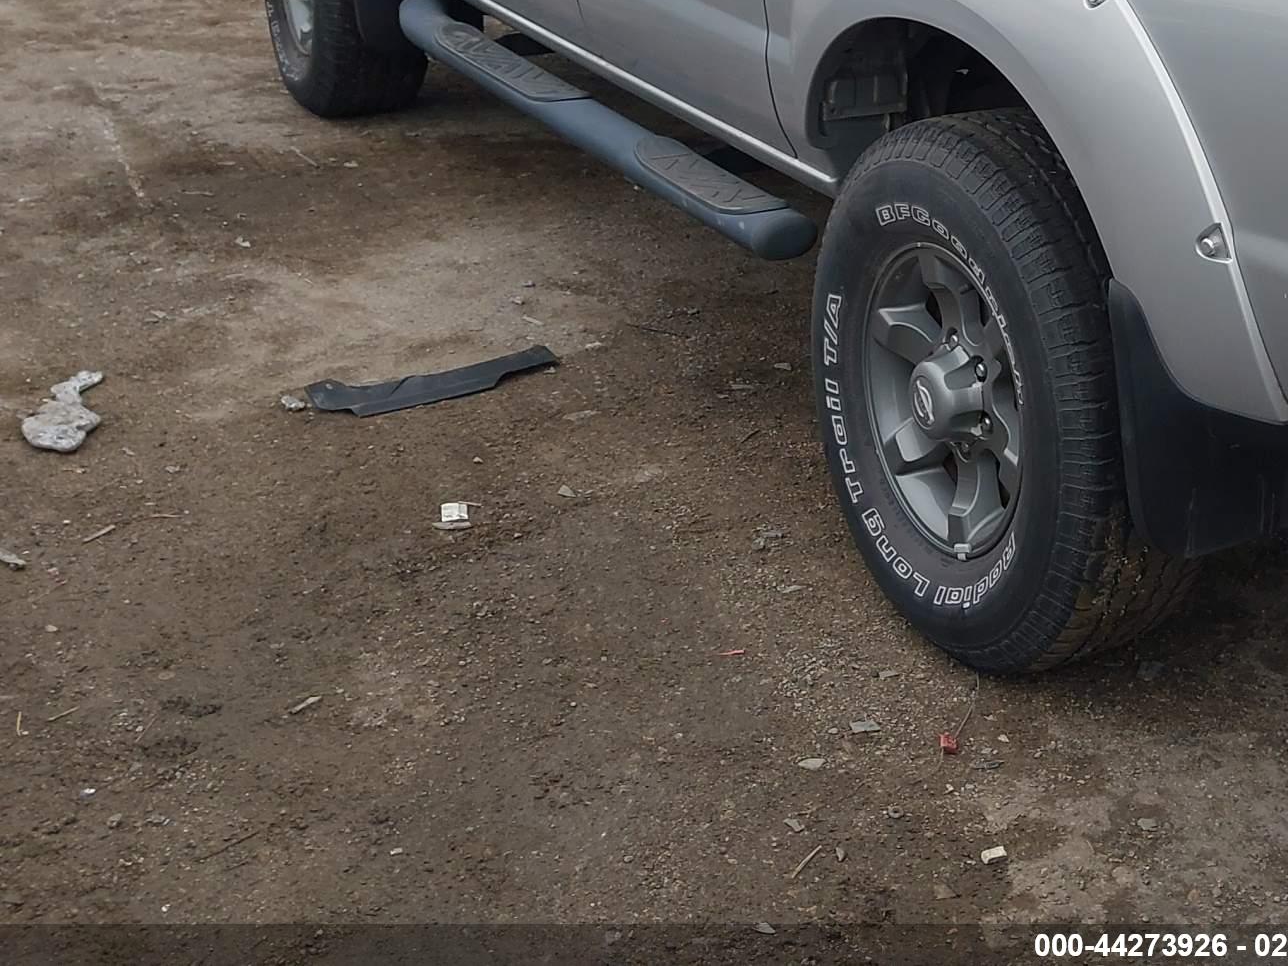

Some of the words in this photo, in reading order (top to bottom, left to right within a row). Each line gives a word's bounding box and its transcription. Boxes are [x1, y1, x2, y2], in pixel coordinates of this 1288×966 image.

[823, 293, 842, 367] T/A
[824, 377, 864, 504] Trail
[861, 507, 931, 597] Long
[933, 530, 1016, 609] Radial
